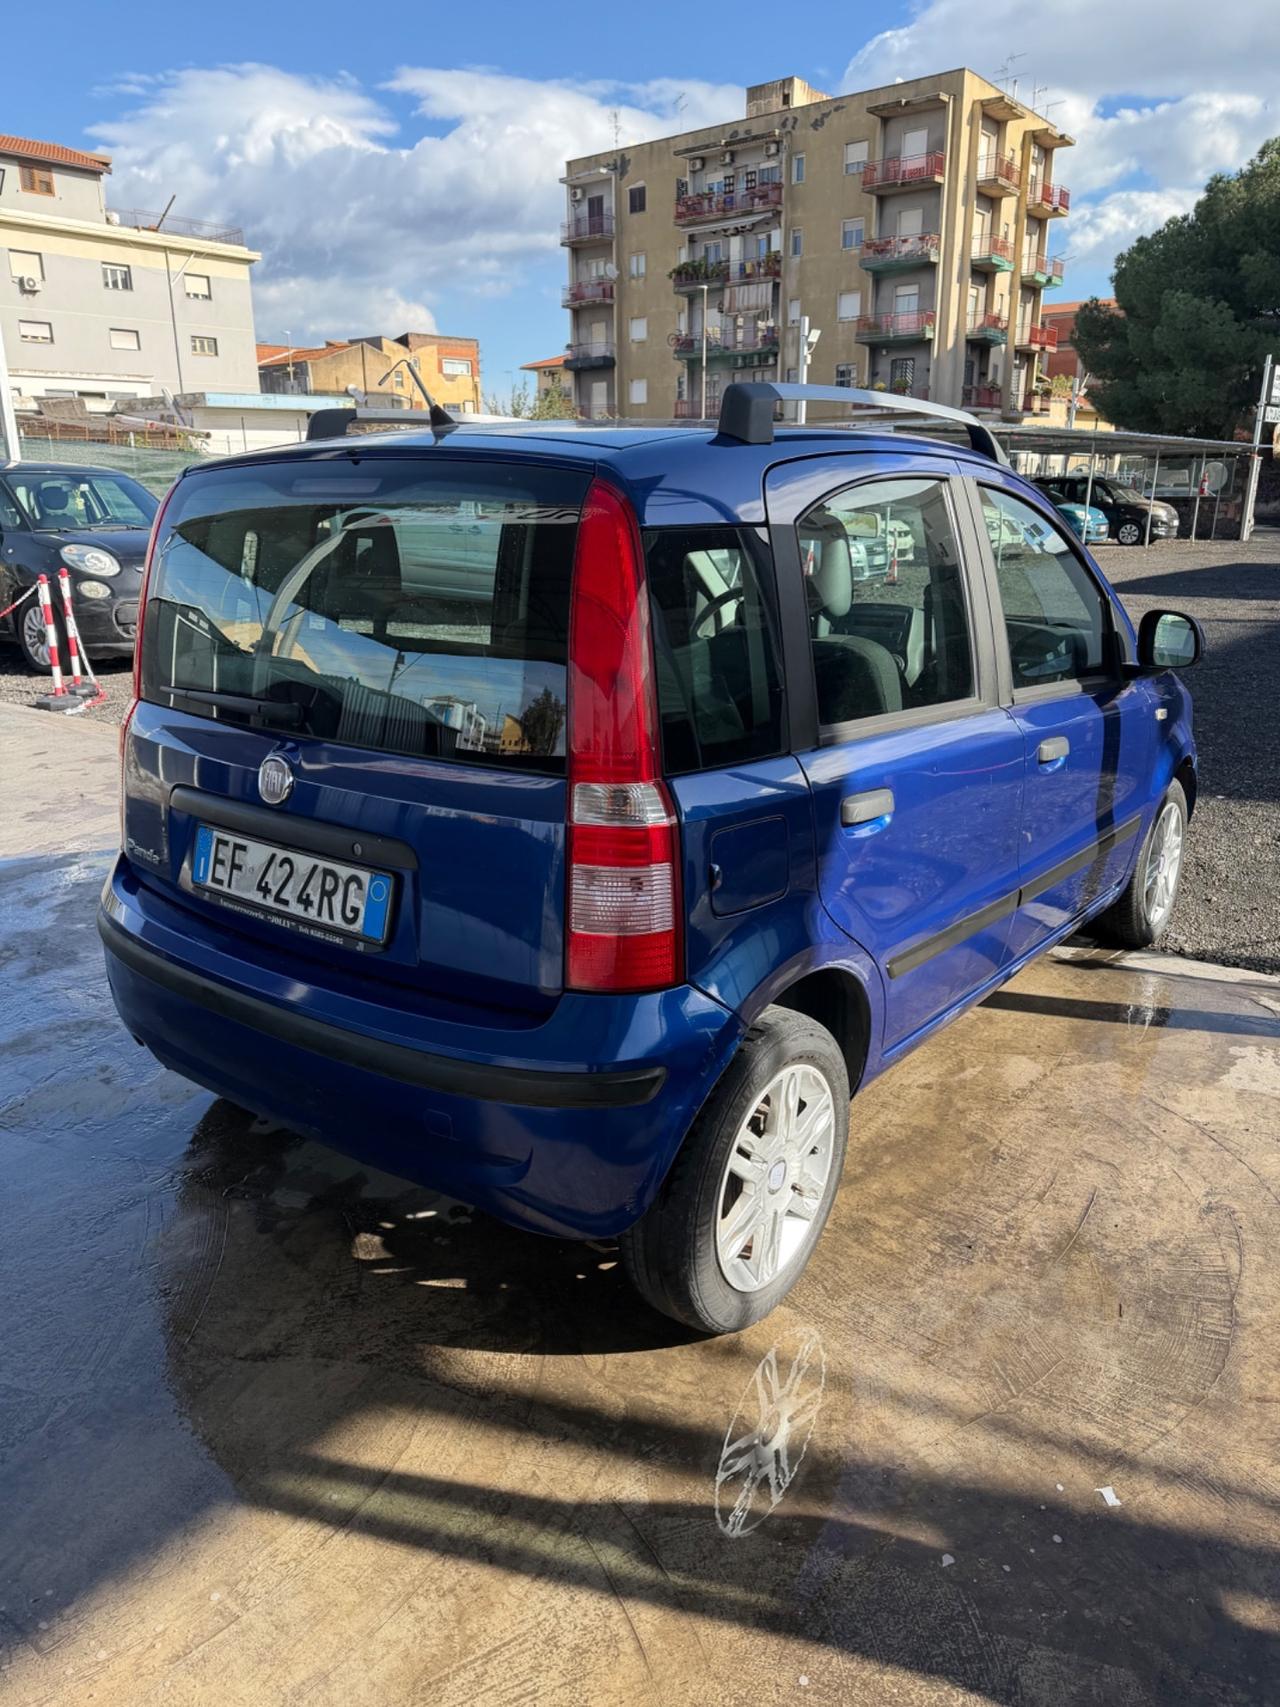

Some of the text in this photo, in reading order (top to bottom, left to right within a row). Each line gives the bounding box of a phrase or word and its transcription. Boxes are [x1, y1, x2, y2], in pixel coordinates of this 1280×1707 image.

[264, 768, 283, 794] FIAT
[210, 837, 364, 926] EF 424RG
